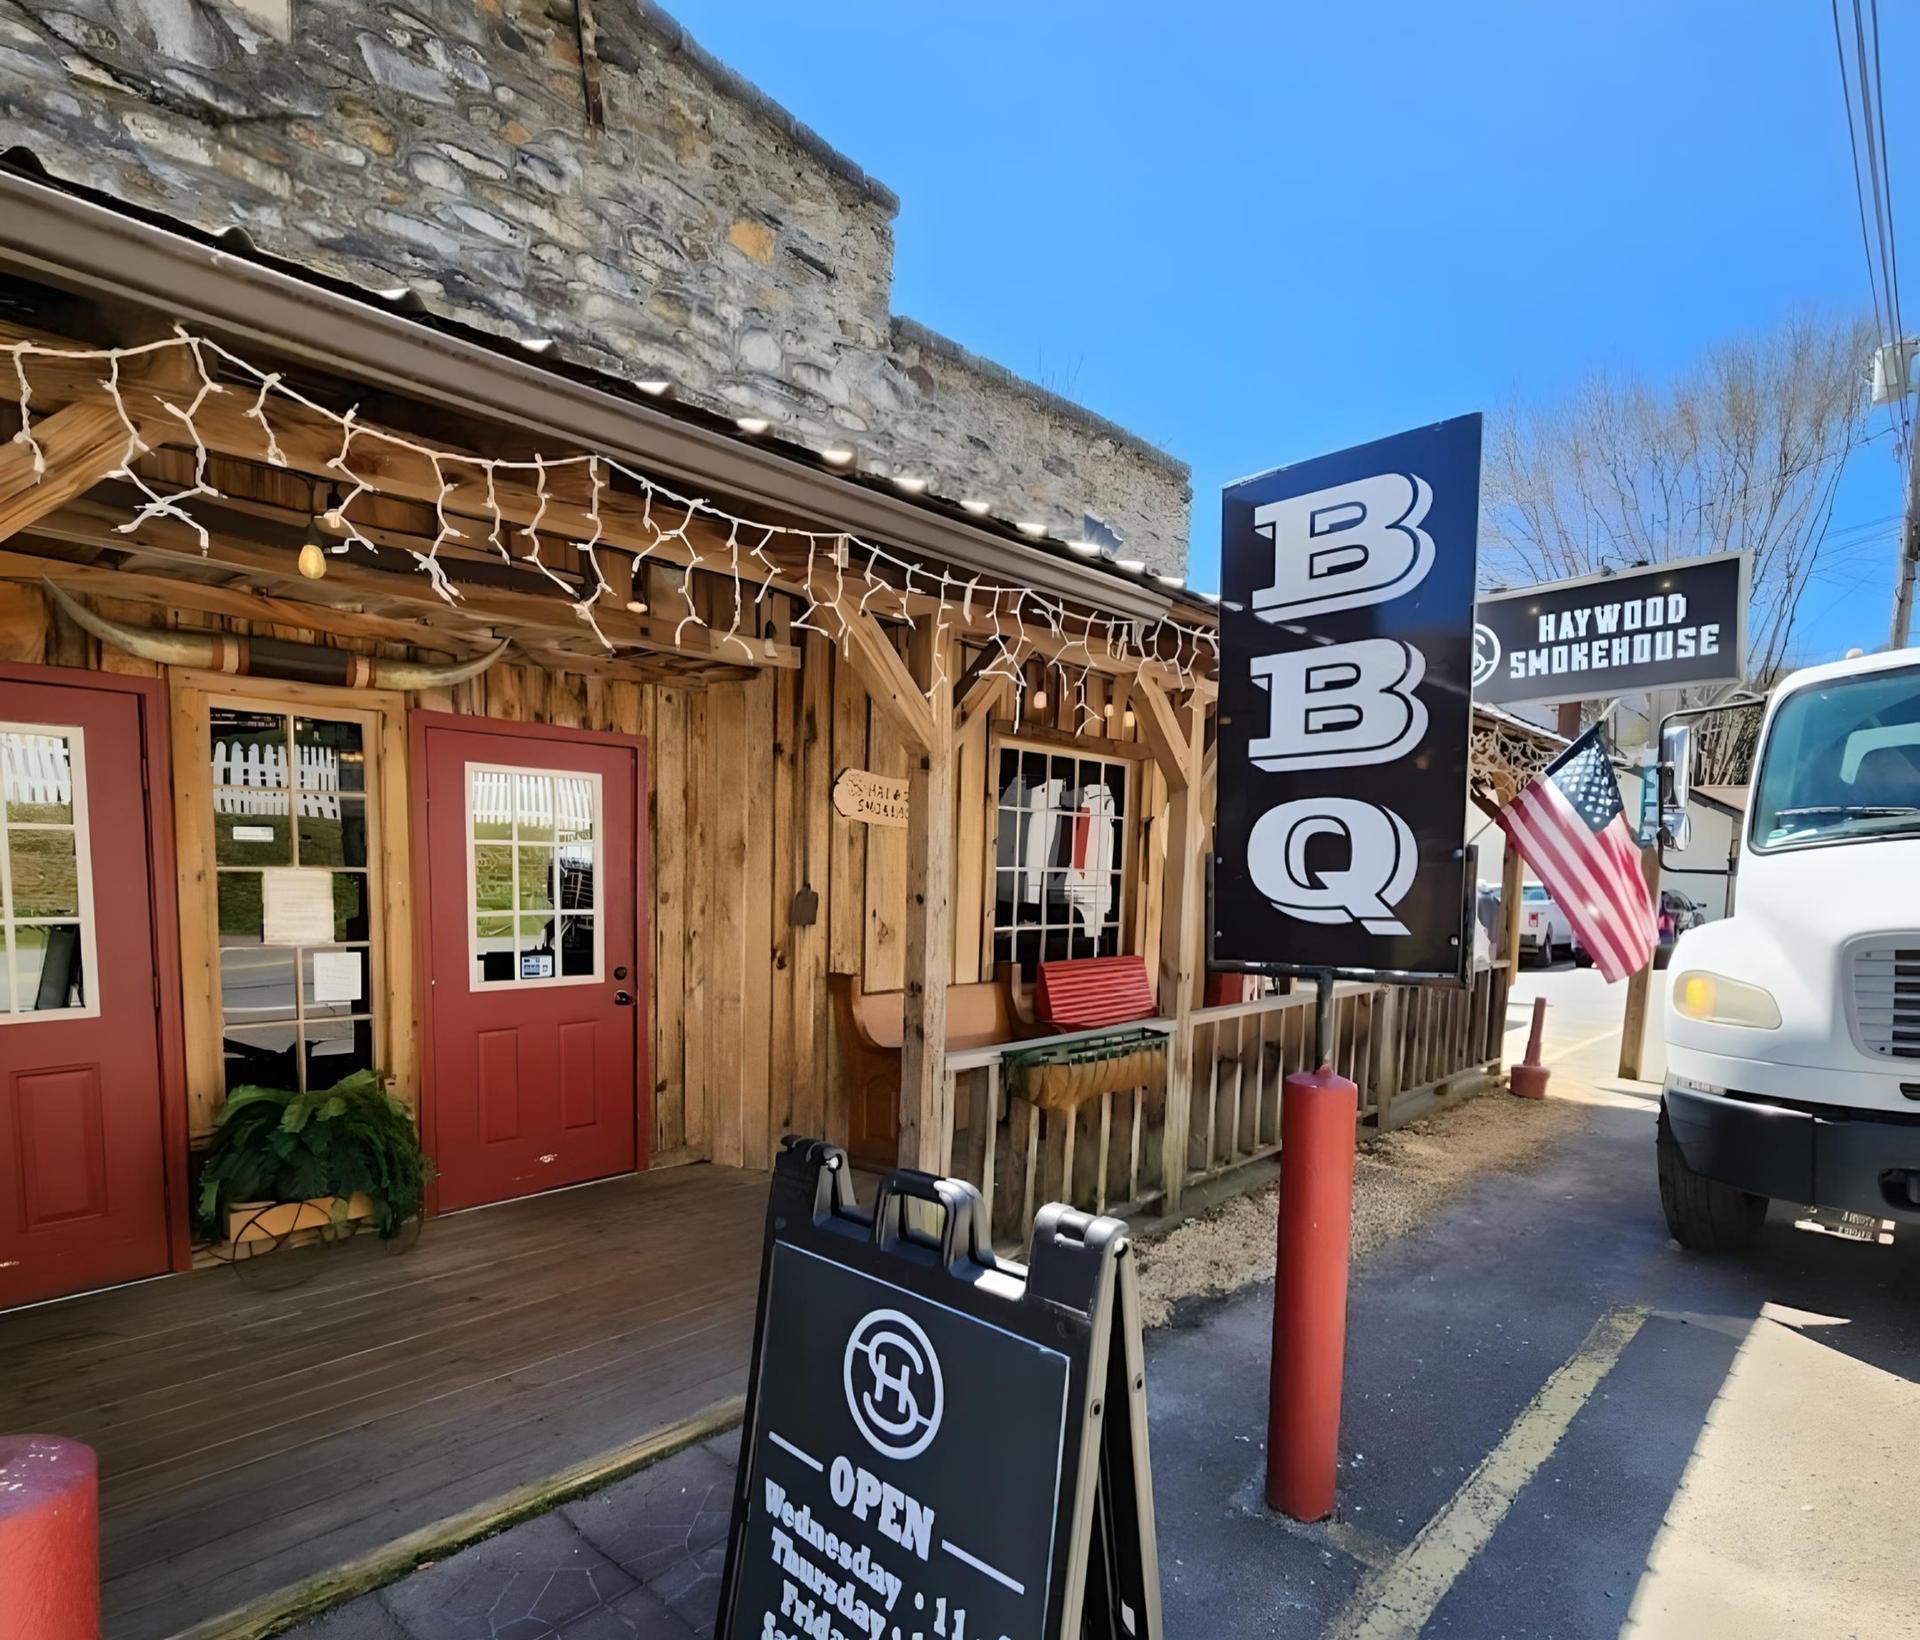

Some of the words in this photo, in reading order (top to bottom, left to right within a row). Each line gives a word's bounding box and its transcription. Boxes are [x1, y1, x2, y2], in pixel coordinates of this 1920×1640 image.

[1510, 624, 1720, 679] SMOKEHOUSE
[1538, 593, 1687, 643] HAYWOOD
[1247, 472, 1436, 936] BBQ
[765, 1477, 903, 1612] Wednesday
[829, 1456, 934, 1561] OPEN
[771, 1526, 887, 1640] Thursday
